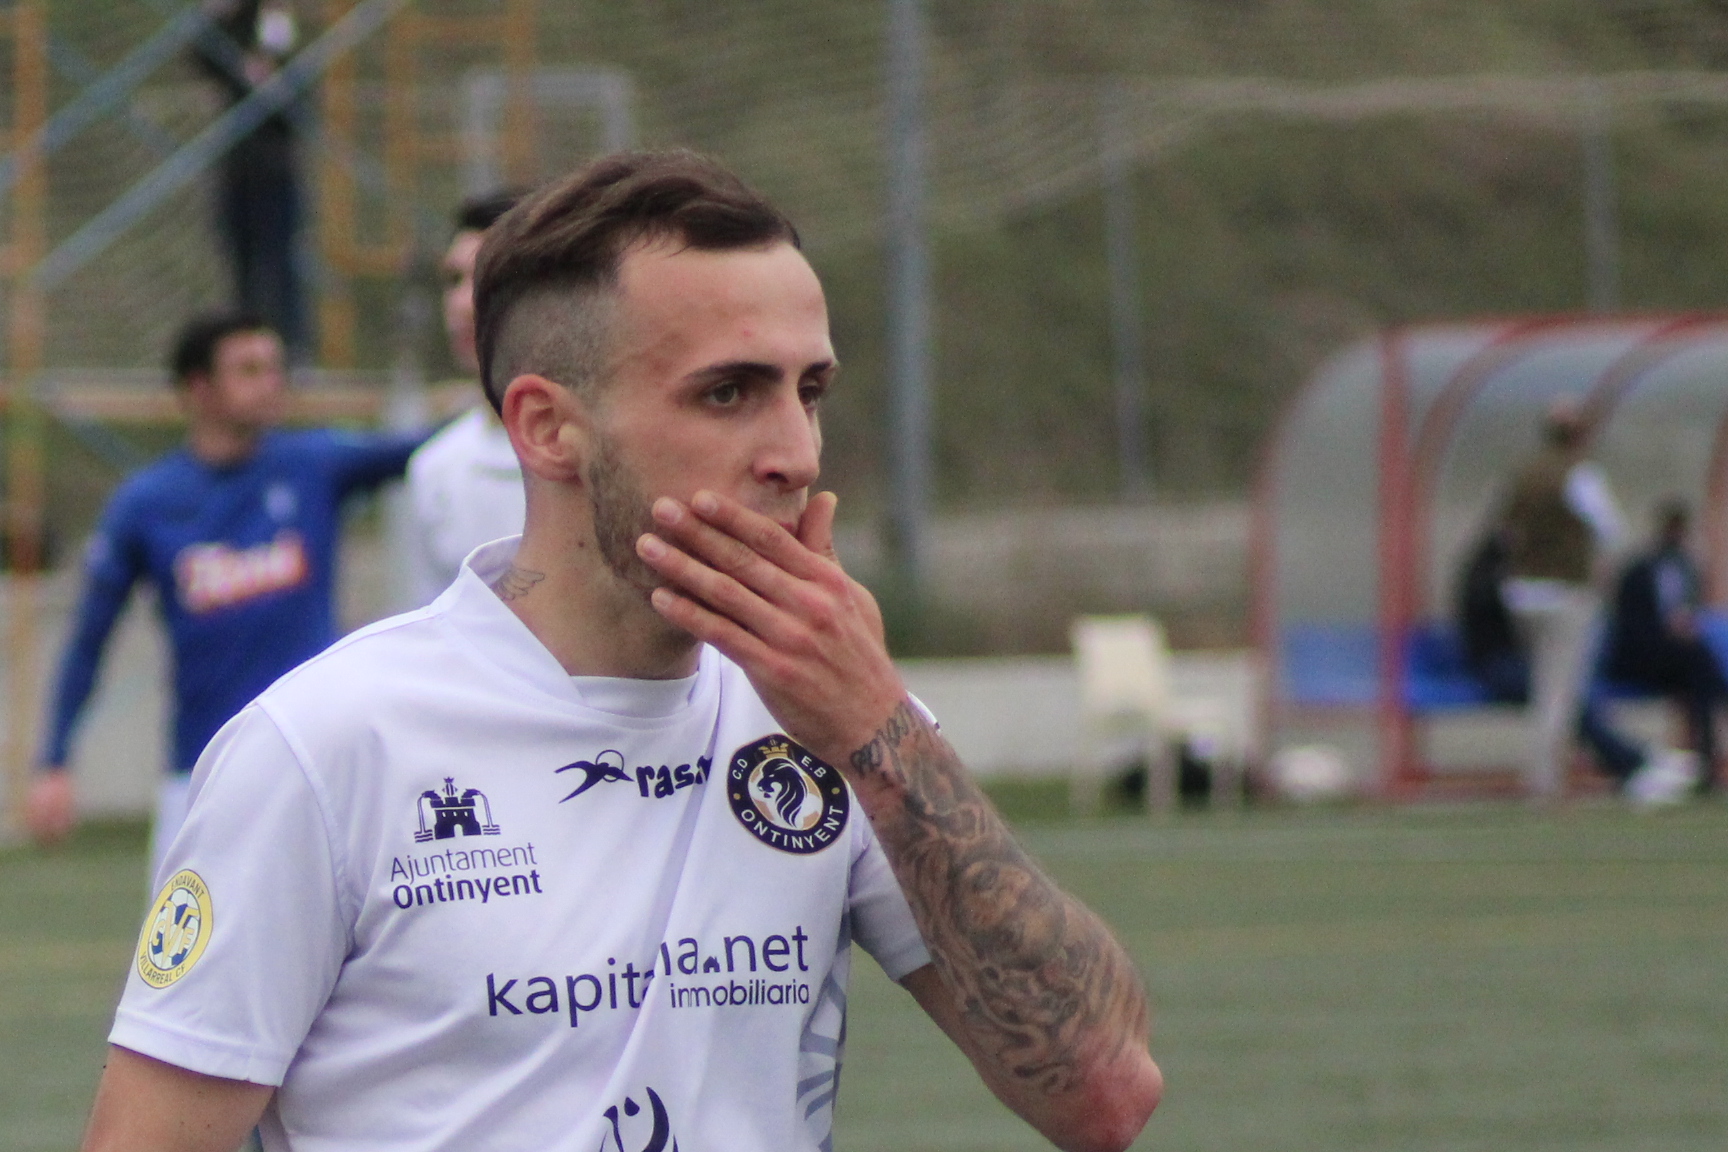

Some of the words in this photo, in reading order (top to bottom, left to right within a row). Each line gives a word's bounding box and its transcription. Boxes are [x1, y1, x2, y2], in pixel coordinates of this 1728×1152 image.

[740, 804, 844, 850] ONTINYENT
[390, 842, 538, 885] Ajuntament
[392, 869, 543, 909] Ontinyent
